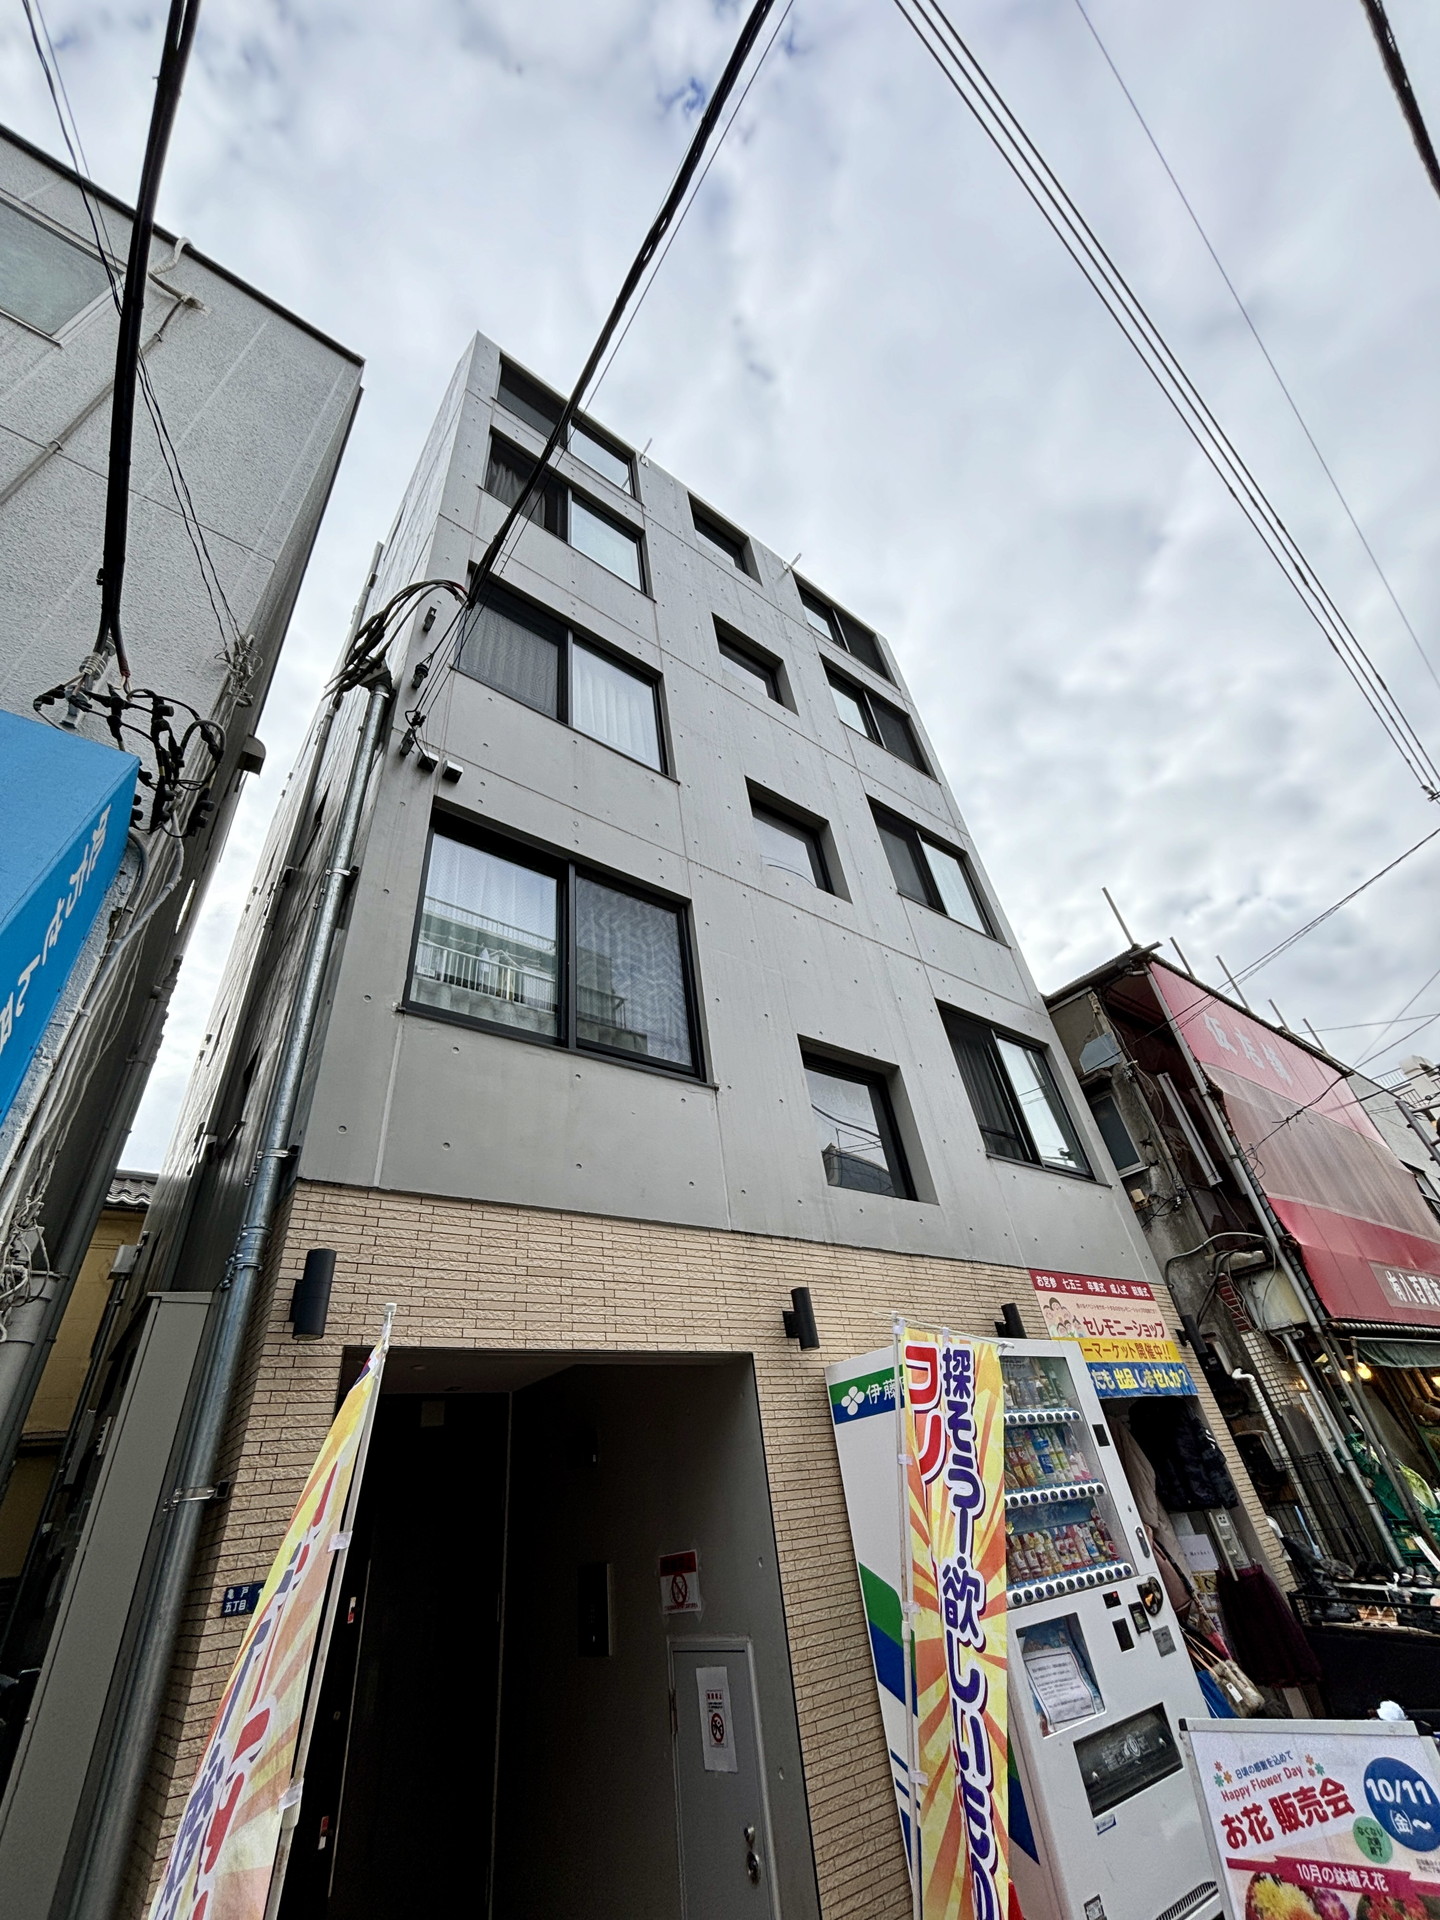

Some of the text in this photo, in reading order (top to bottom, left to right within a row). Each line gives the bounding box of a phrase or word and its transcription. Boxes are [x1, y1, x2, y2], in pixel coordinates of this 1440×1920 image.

[1062, 1278, 1083, 1290] 七五三
[1086, 1281, 1107, 1293] 卒業式
[1109, 1283, 1129, 1295] 成人式
[1083, 1317, 1165, 1338] セレモニーショップ
[1080, 1342, 1171, 1360] ーマーケット開催中!!
[224, 1599, 247, 1613] 五丁目
[1220, 1765, 1304, 1802] Happy Flower Day
[1365, 1778, 1433, 1805] 10/11
[1295, 1862, 1389, 1893] 10月の鉢植え花
